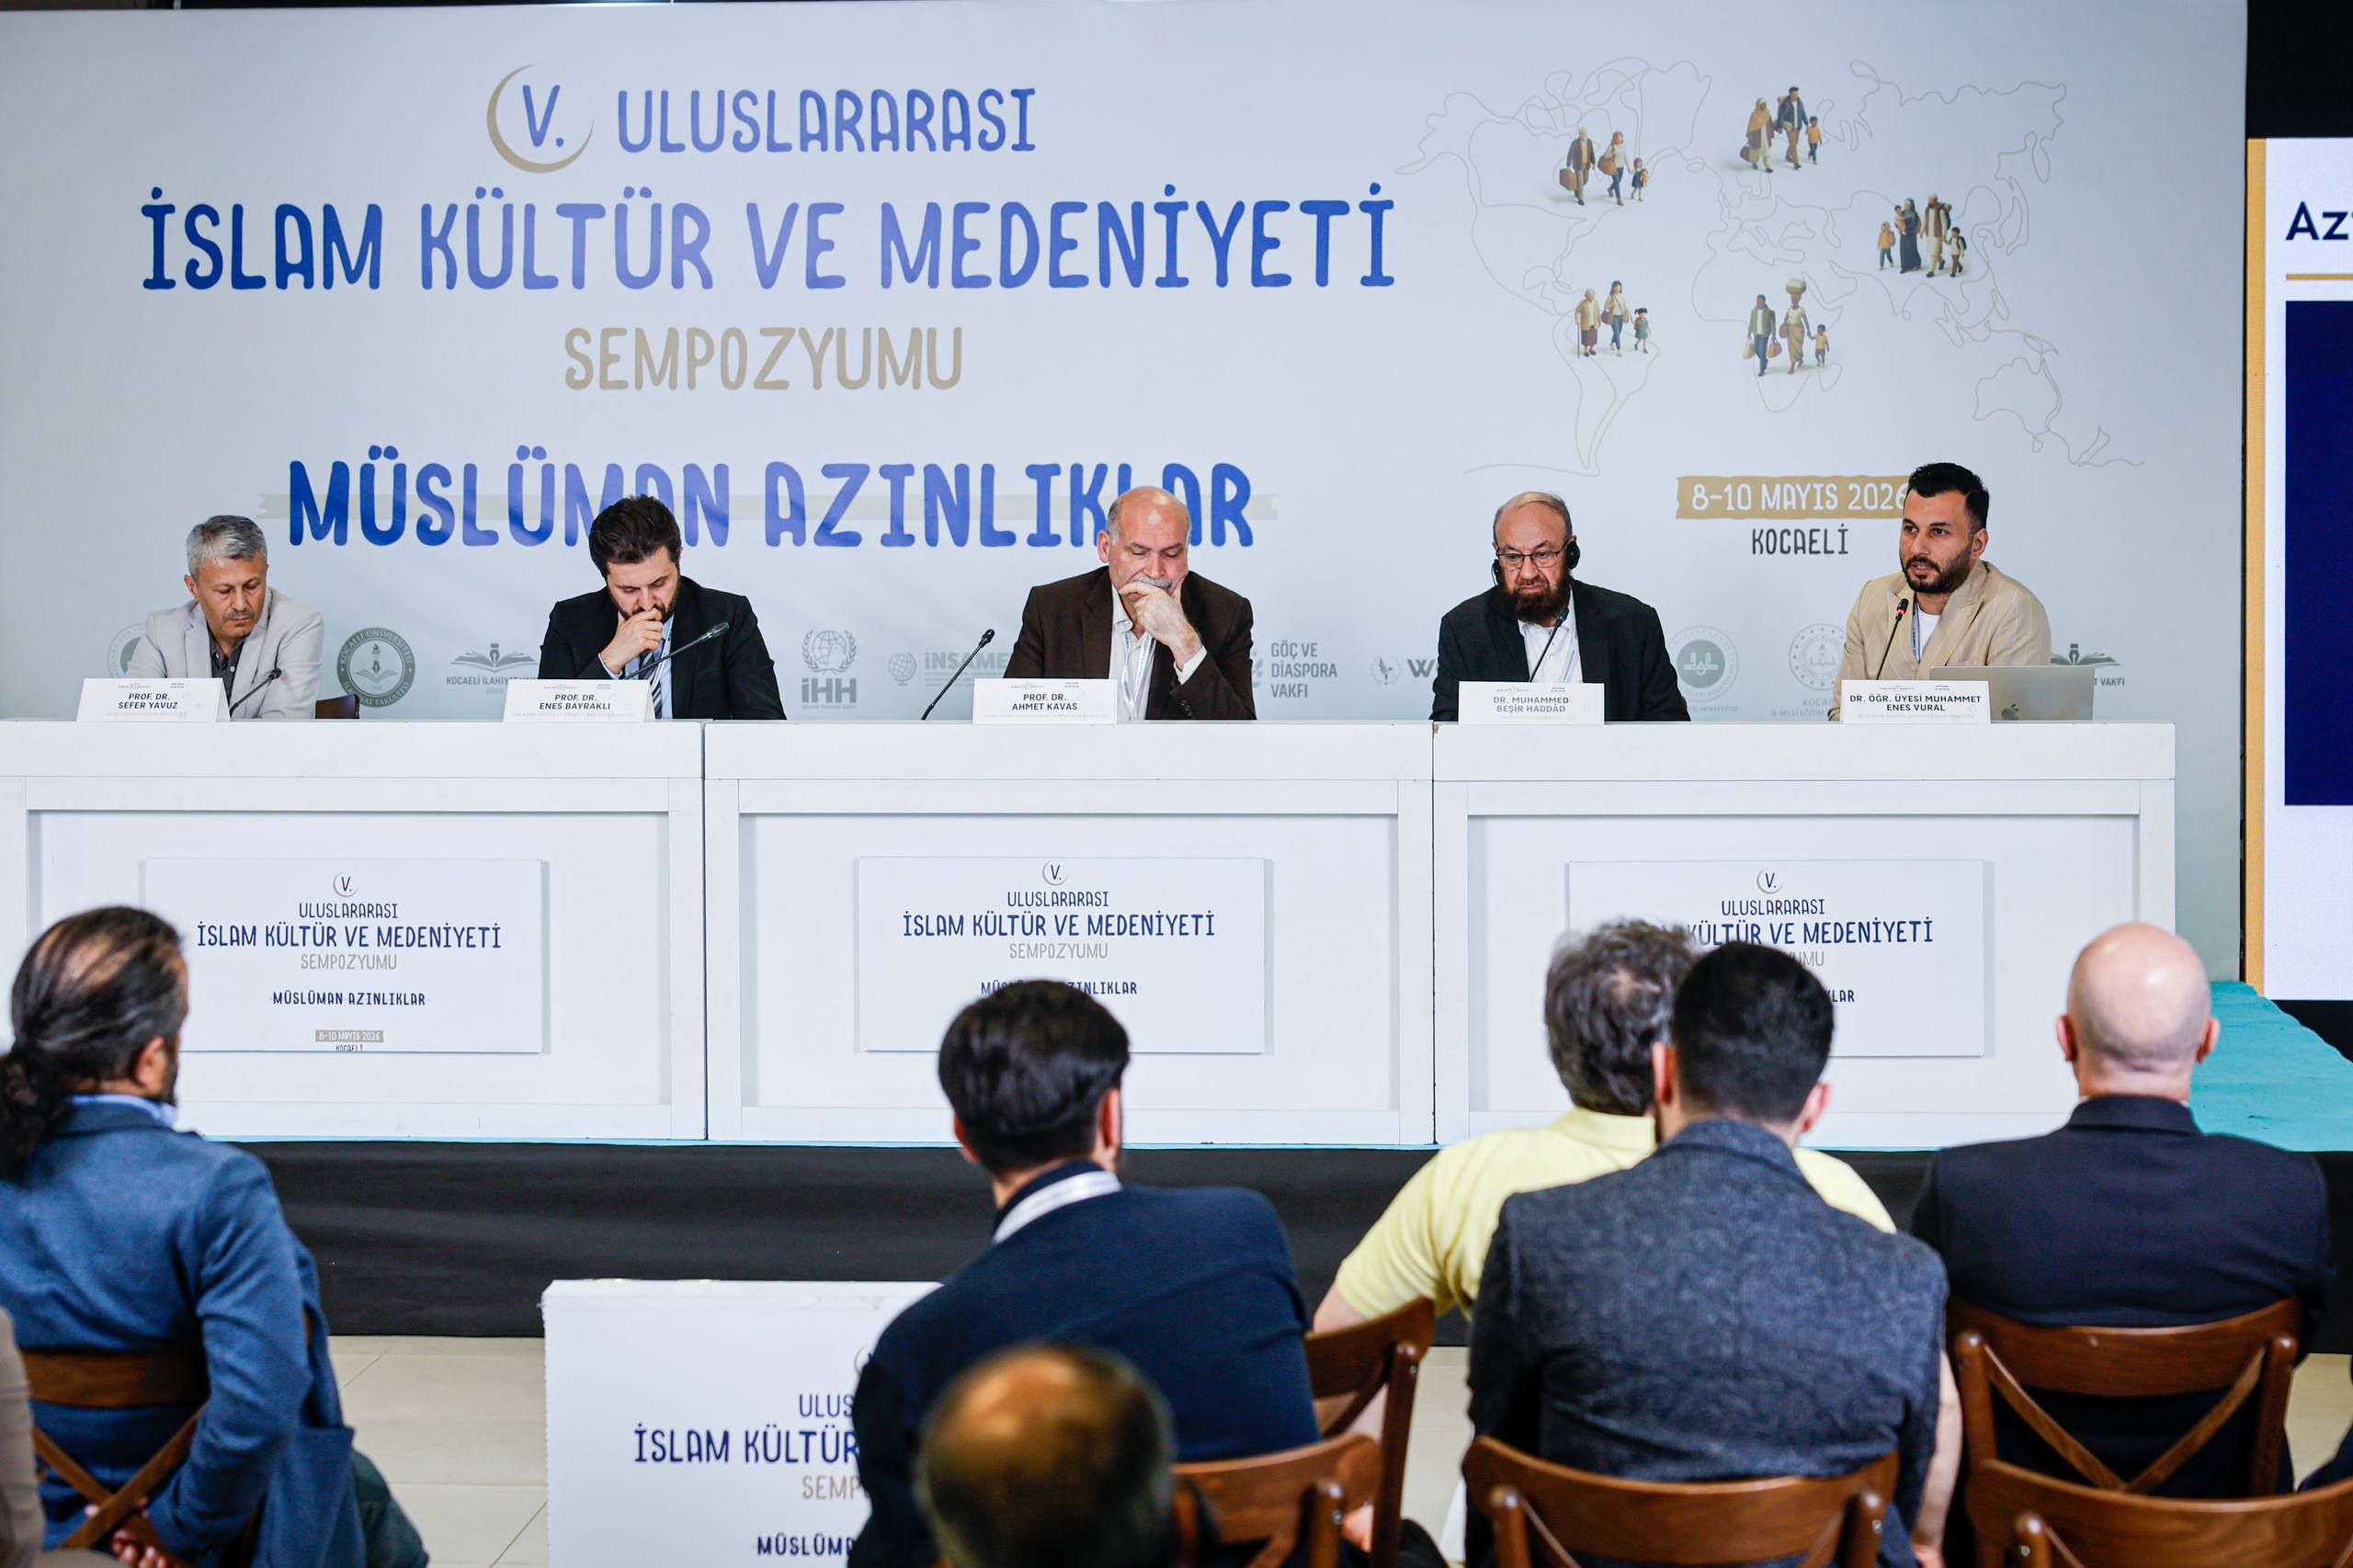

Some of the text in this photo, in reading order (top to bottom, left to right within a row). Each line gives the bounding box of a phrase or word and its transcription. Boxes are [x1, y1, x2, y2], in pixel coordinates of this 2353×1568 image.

[523, 85, 1036, 153] V. ULUSLARARASI
[2285, 200, 2353, 241] Az
[142, 182, 1395, 290] İSLAM KÜLTÜR VE MEDENİYETİ
[564, 326, 963, 391] SEMPOZYUMU
[1691, 482, 1908, 511] 8-10 MAYIS 2026
[1752, 523, 1849, 555] KOCAELİ
[1271, 640, 1318, 659] GÖÇ VE
[1271, 660, 1338, 678] DİASPORA
[1406, 659, 1439, 677] W
[447, 675, 517, 685] KOCAELİ İLAHİY
[2100, 677, 2125, 687] VAKFI
[128, 692, 170, 700] PROF. DR.
[1023, 693, 1067, 701] PROF. DR.
[1271, 684, 1308, 699] VAKFI
[1849, 695, 1866, 703] DR.
[1869, 693, 1892, 703] ÖĞR.
[1894, 693, 1923, 703] ÜYESİ
[118, 701, 178, 710] SEFER YAVUZ
[539, 702, 611, 710] ENES BAYRAKLI
[1012, 702, 1078, 710] AHMET KAVAS
[1496, 705, 1524, 714] BEŞİR
[1886, 703, 1946, 711] ENES VURAL
[1050, 864, 1062, 881] V.
[1765, 872, 1777, 889] V.
[341, 876, 352, 892] V.
[1007, 891, 1109, 907] ULUSLARARASI
[1721, 898, 1825, 916] ULUSLARARASI
[299, 902, 398, 919] ULUSLARARASI
[903, 909, 1215, 937] İSLAM KÜLTÜR VE MEDENİYETİ
[1769, 922, 1796, 945] VE
[1803, 916, 1933, 945] MEDENİYETİ
[197, 920, 501, 949] İSLAM KÜLTÜR VE MEDENİYETİ
[1009, 942, 1108, 960] SEMPOZYUMU
[301, 953, 397, 971] SEMPOZYUMU
[1067, 982, 1138, 995] INLIKLAR
[273, 989, 426, 1006] MÜSLÜMAN AZINLIKLAR
[338, 1031, 360, 1040] MAYIS
[362, 1031, 381, 1041] 2026
[799, 1393, 853, 1417] ULUS
[633, 1423, 859, 1464] İSLAM KÜLTÜR
[802, 1474, 870, 1500] SEMP
